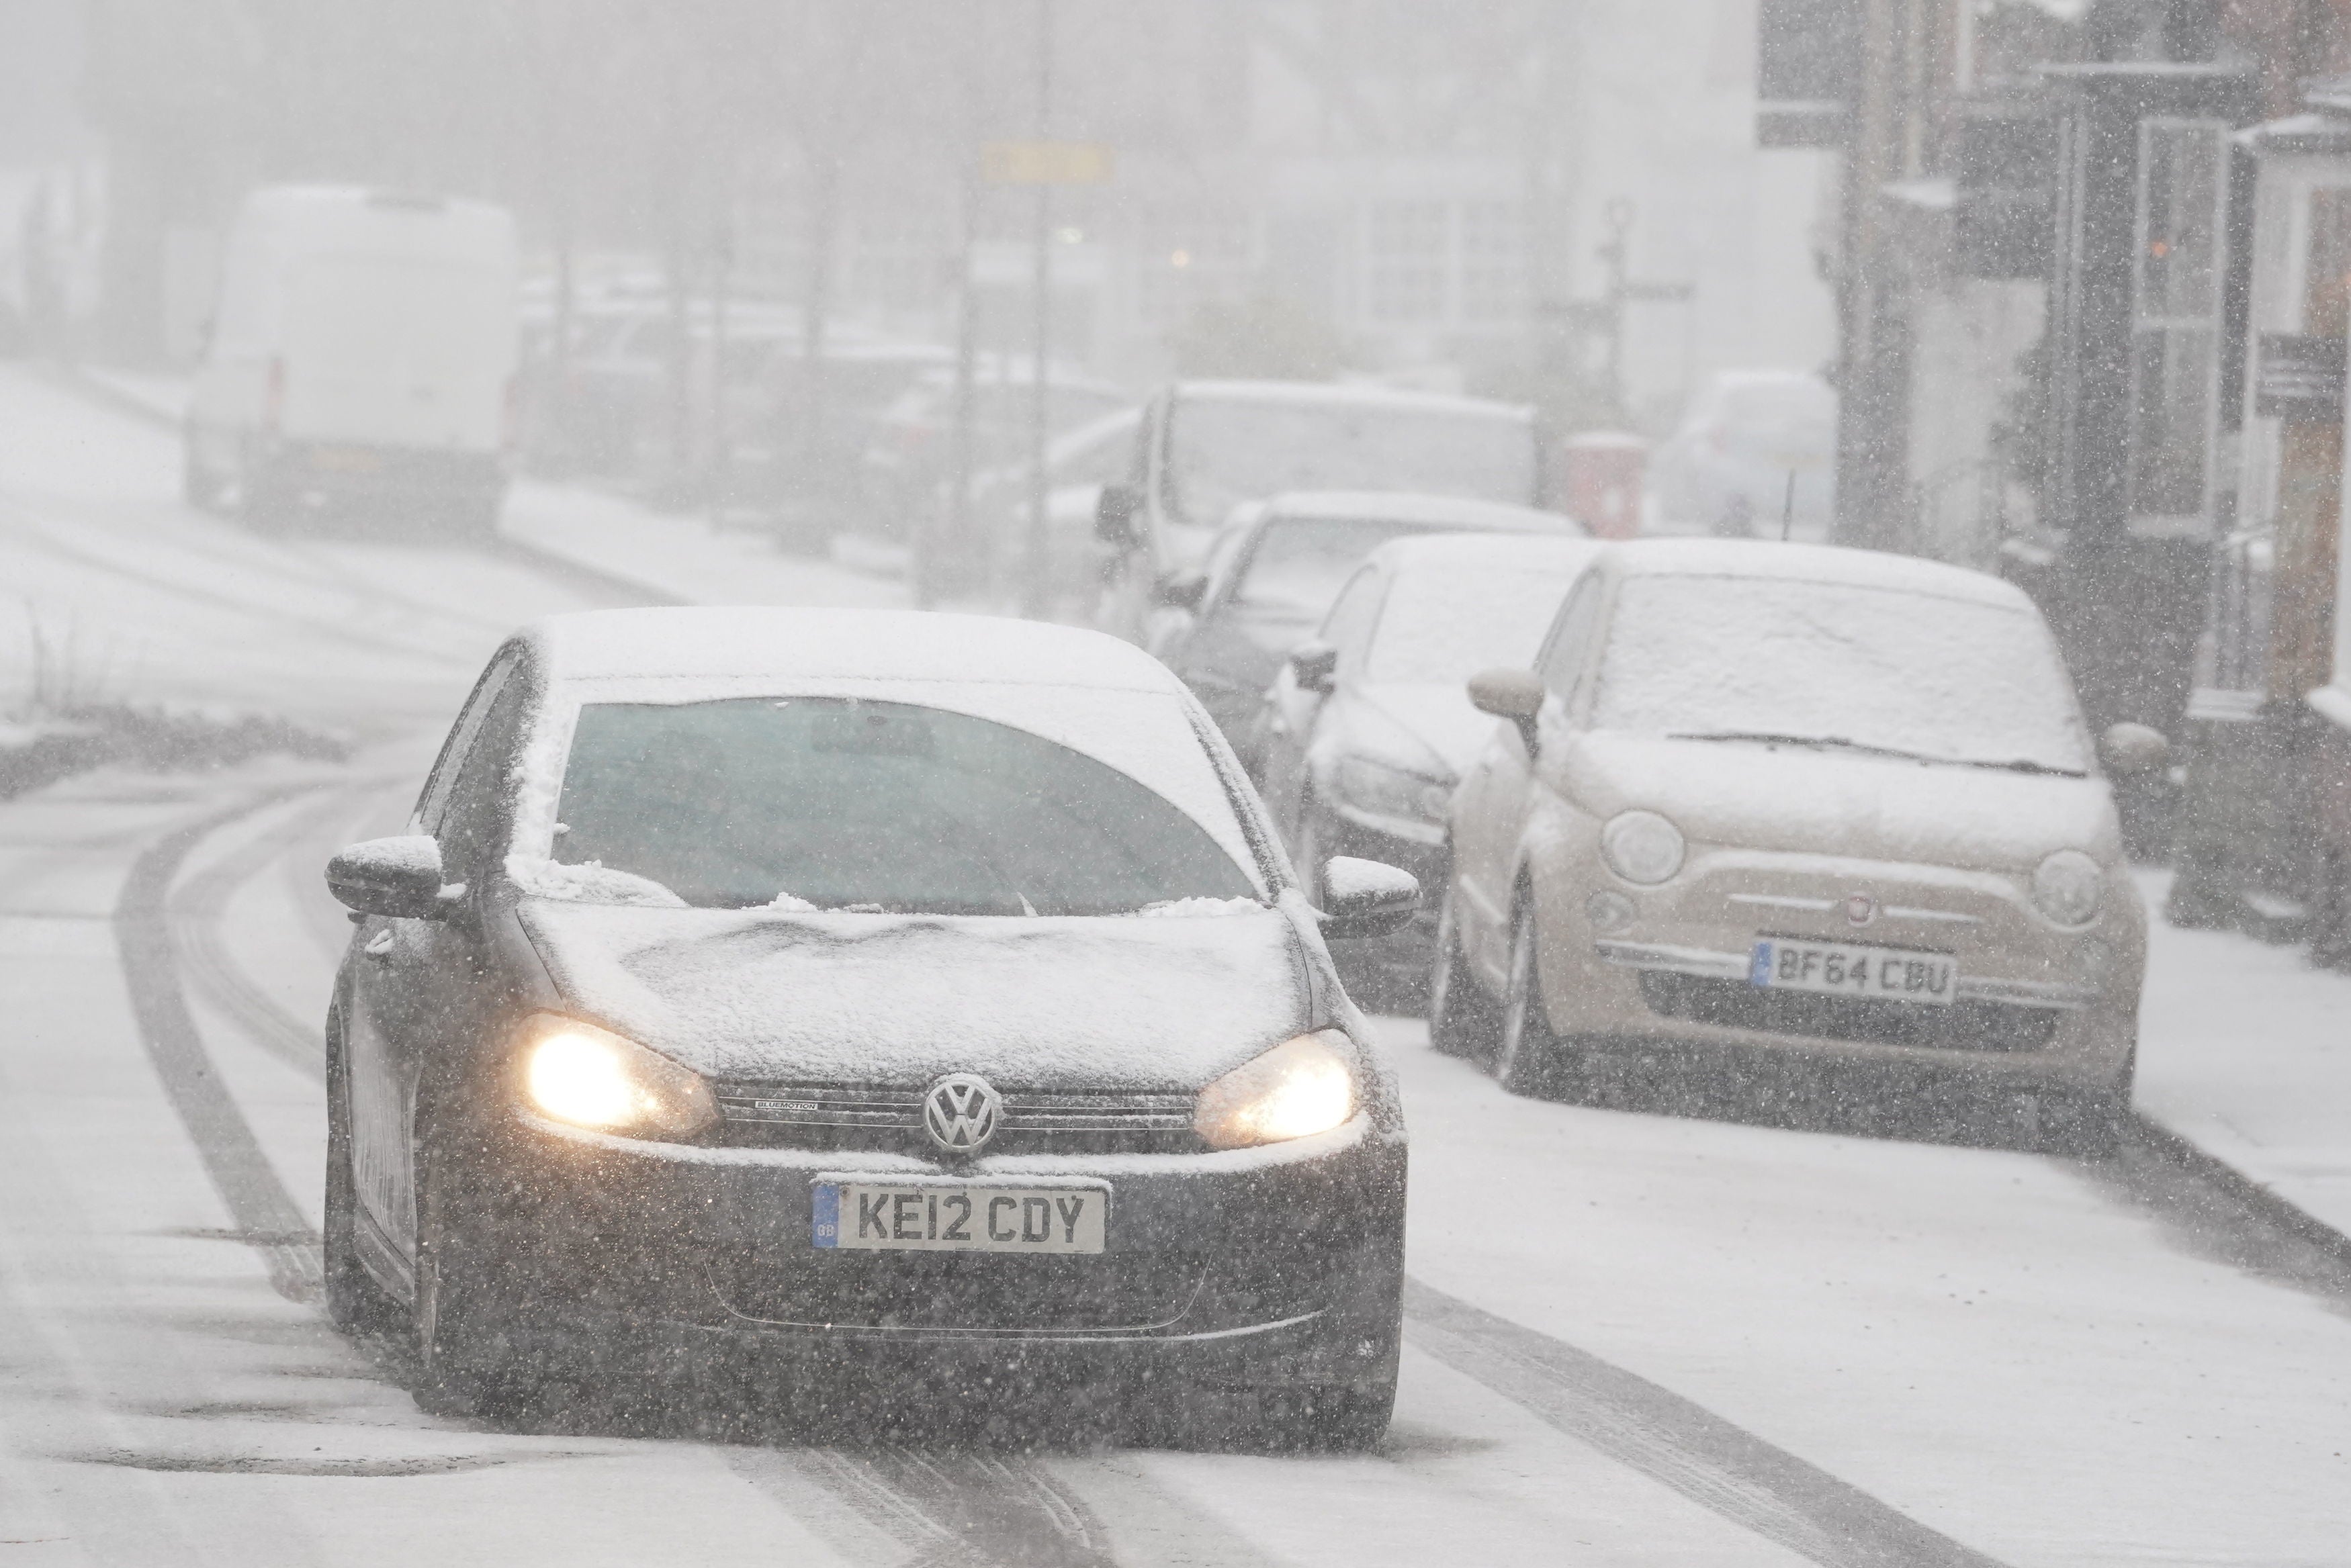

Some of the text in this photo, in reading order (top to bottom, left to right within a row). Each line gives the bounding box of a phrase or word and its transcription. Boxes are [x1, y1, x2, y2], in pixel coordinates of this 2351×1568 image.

[1779, 947, 1949, 995] BF64 CBU
[757, 1101, 816, 1109] BLUEMOTION
[817, 1224, 835, 1237] GB
[858, 1193, 1085, 1244] KE12 CDY
